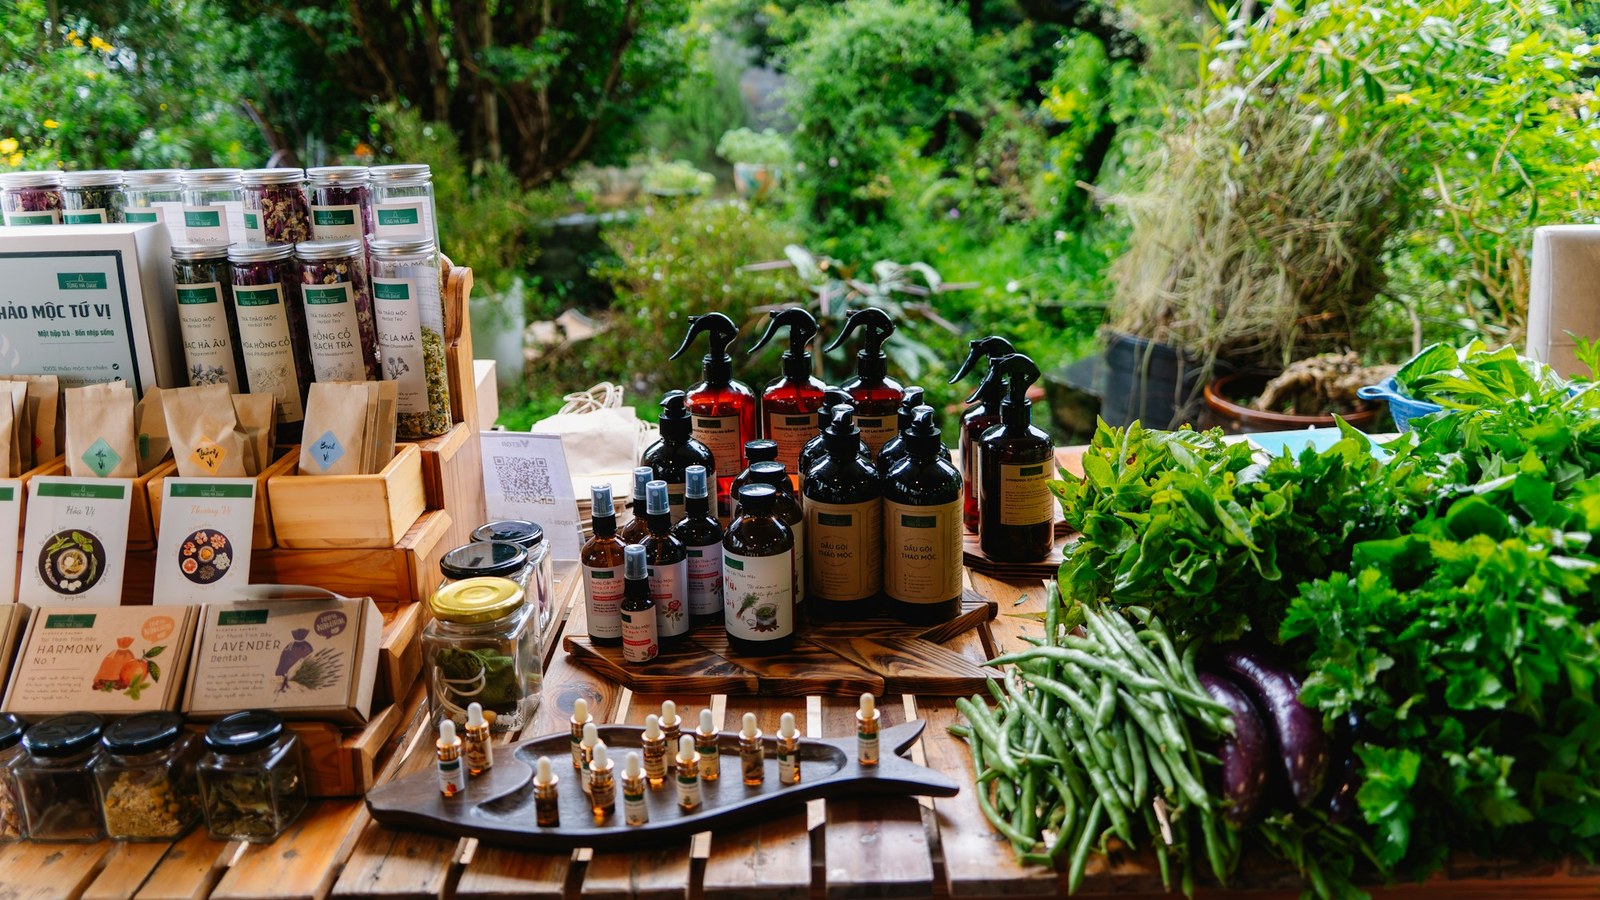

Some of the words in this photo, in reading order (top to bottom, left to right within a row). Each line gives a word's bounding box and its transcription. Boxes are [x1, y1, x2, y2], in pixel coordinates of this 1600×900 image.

[31, 302, 66, 321] MỘC
[69, 301, 90, 318] TỨ
[94, 304, 111, 320] VỊ
[38, 330, 49, 338] Một
[50, 330, 61, 338] hộp
[101, 328, 114, 337] sống
[313, 330, 335, 340] HỒNG
[338, 327, 351, 339] CỔ
[401, 332, 415, 341] MÃ
[198, 340, 210, 348] HÀ
[213, 338, 226, 348] ÂU
[254, 339, 276, 349] HỒNG
[279, 336, 290, 347] CỔ
[314, 342, 334, 351] BẠCH
[336, 339, 353, 350] TRÀ
[902, 552, 918, 560] THẢO
[36, 644, 103, 654] HARMONY
[213, 640, 281, 652] LAVENDER
[211, 654, 248, 663] Dentata
